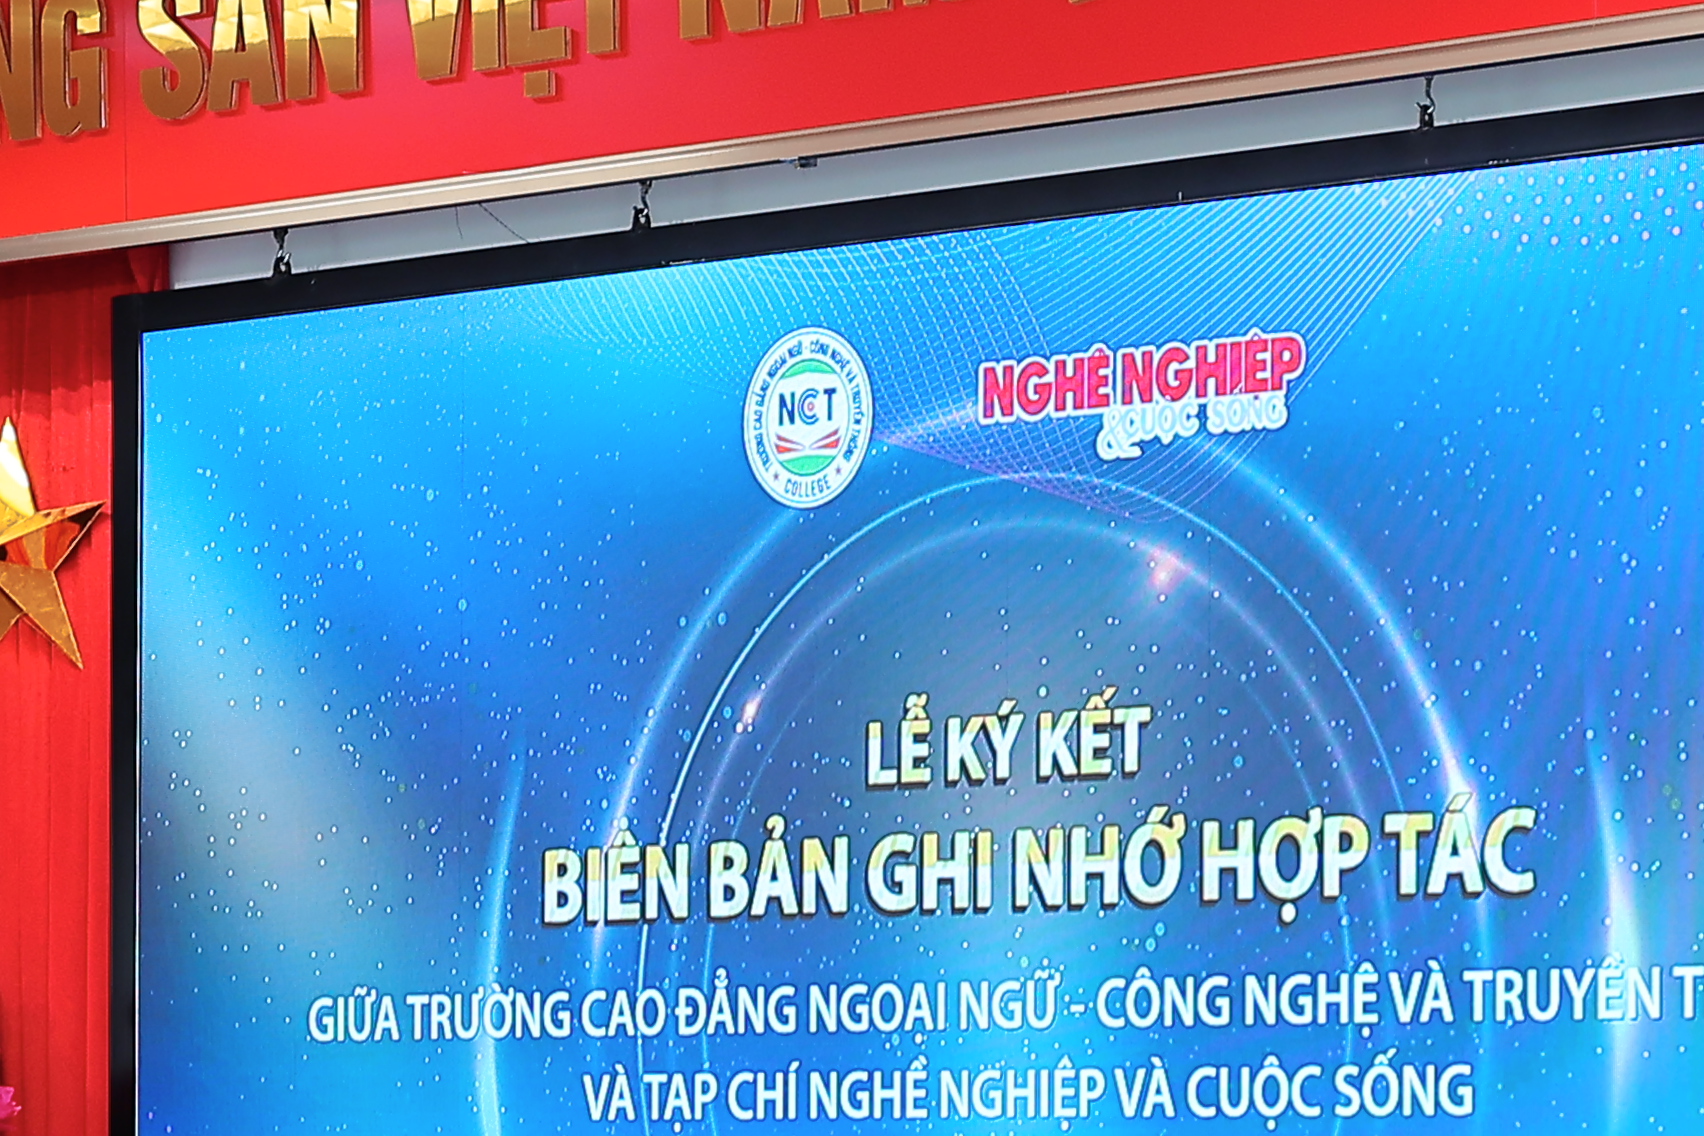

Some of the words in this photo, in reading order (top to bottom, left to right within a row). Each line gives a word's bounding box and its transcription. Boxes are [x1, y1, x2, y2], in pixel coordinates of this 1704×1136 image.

[778, 387, 837, 426] NCT
[784, 474, 832, 498] COLLEGE
[867, 693, 932, 786] LỄ
[946, 699, 1024, 782] KÝ
[1038, 686, 1152, 778] KẾT
[543, 828, 690, 925] BIÊN
[707, 814, 850, 919] BẢN
[867, 829, 994, 914] GHI
[1013, 805, 1186, 910] NHỚ
[1201, 806, 1370, 924] HỢP
[1382, 792, 1536, 897] TÁC
[309, 986, 400, 1042] GIỮA
[405, 983, 571, 1040] TRƯỜNG
[581, 988, 666, 1037] CAO
[674, 968, 798, 1036] ĐẲNG
[809, 981, 947, 1044] NGOẠI
[959, 968, 1062, 1031] NGỮ
[1096, 966, 1231, 1029] CÔNG
[1244, 961, 1379, 1038] NGHỆ
[1388, 960, 1454, 1023] VÀ
[1462, 952, 1662, 1021] TRUYỀN
[583, 1063, 635, 1121] VÀ
[643, 1072, 718, 1133] TẠP
[727, 1061, 800, 1120] CHÍ
[809, 1055, 928, 1120] NGHỀ
[940, 1056, 1105, 1131] NGHIỆP
[1115, 1057, 1176, 1118] VÀ
[1187, 1056, 1322, 1131] CUỘC
[1332, 1048, 1473, 1117] SỐNG
